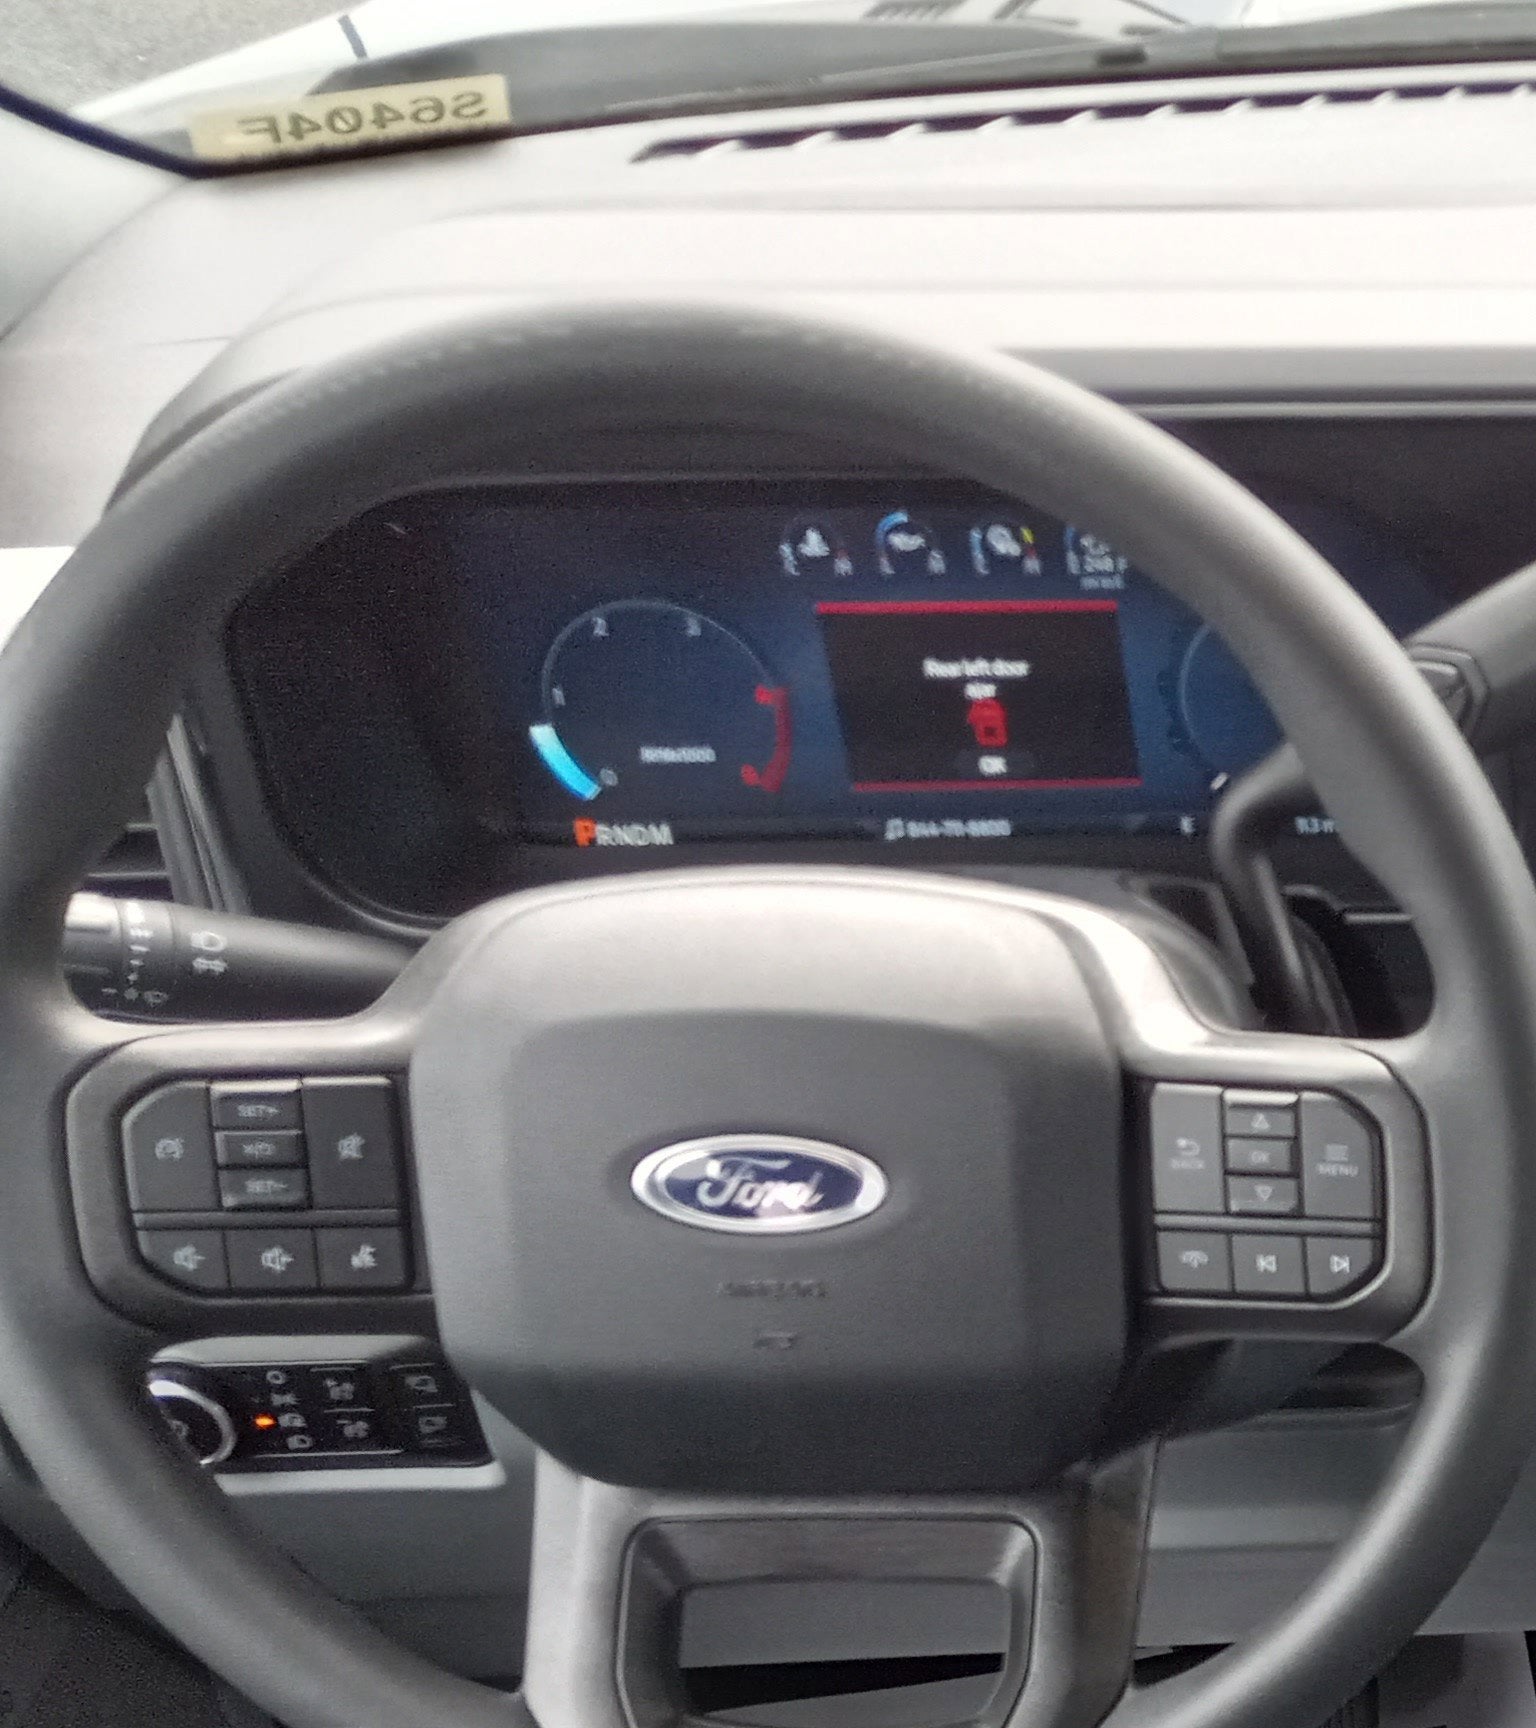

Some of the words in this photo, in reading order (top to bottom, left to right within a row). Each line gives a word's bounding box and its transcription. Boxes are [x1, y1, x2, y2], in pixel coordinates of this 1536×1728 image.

[923, 657, 961, 677] Rear
[1317, 1163, 1359, 1177] MENU
[697, 1156, 824, 1210] Ford
